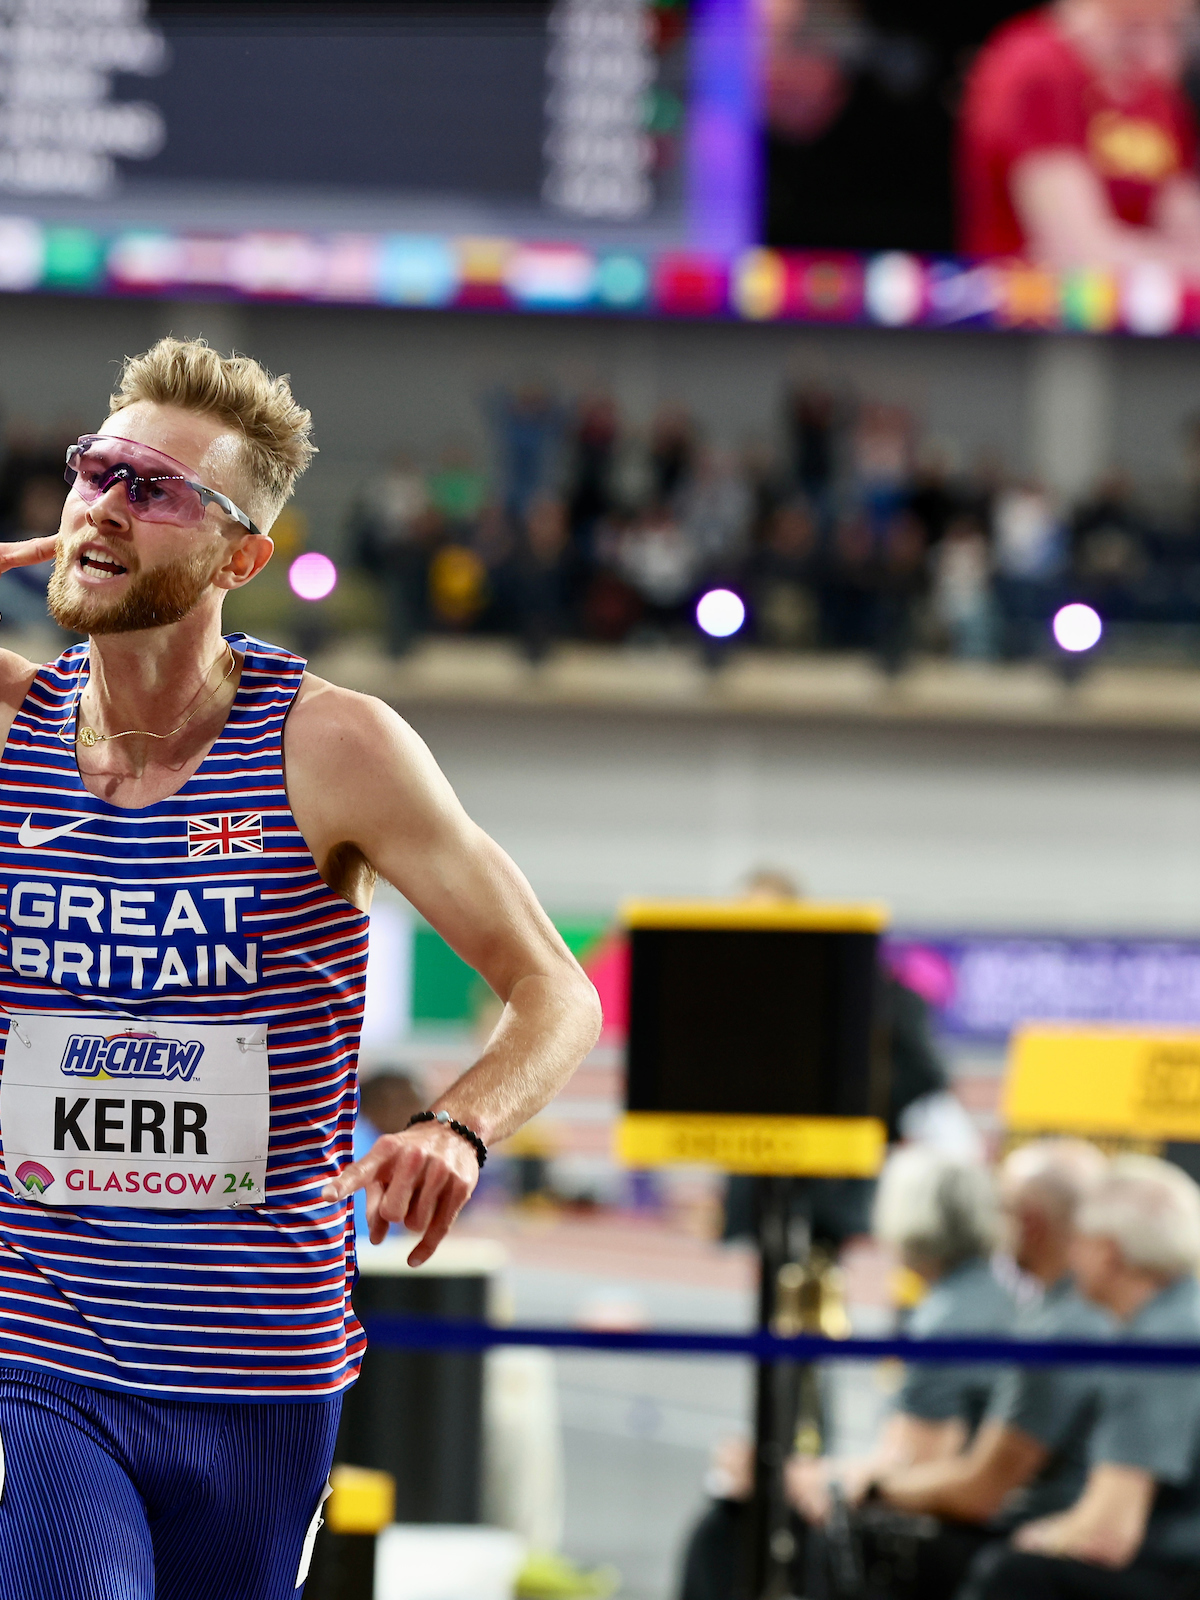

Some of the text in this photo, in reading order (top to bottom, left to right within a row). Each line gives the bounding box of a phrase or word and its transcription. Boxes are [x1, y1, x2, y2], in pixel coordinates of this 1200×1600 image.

[9, 881, 255, 936] GREAT
[10, 937, 258, 990] BRITAIN
[60, 1034, 205, 1081] HI-CHEW
[53, 1096, 209, 1155] KERR
[65, 1168, 255, 1194] GLASGOW 24
